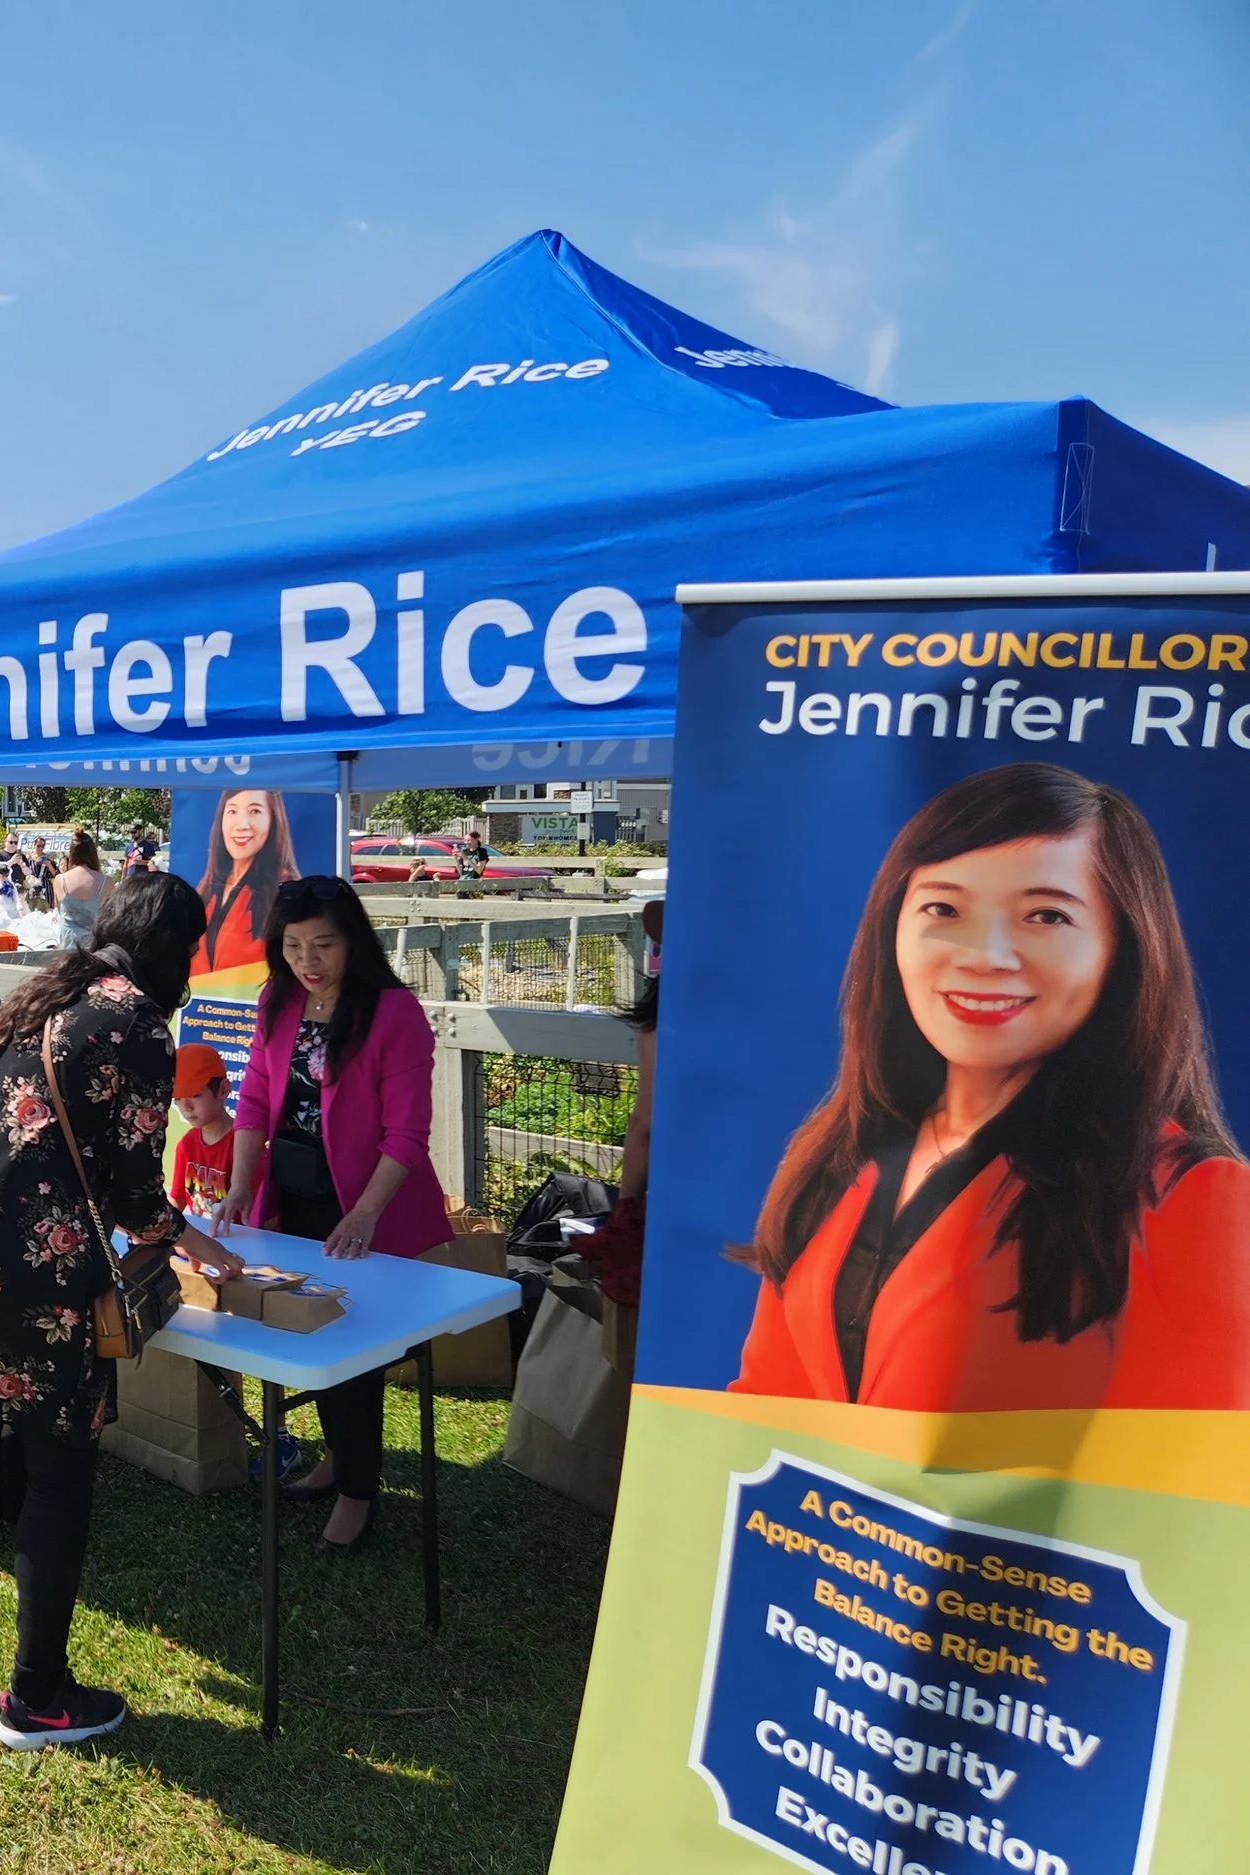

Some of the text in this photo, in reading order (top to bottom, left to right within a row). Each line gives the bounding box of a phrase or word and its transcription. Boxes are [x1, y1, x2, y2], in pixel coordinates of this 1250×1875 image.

[207, 359, 610, 461] Jennifer Rice
[290, 410, 426, 457] YEG
[280, 570, 649, 723] Rice
[765, 632, 1249, 671] CITY COUNCILLOR
[758, 677, 1104, 743] Jennifer
[531, 817, 578, 829] VISTA
[197, 1004, 258, 1019] A Common-Se
[224, 1021, 234, 1030] to
[235, 1021, 256, 1033] Gett
[745, 1510, 1154, 1672] Approach to Getting the
[799, 1489, 1093, 1605] A Common-Sense
[814, 1578, 1048, 1685] Balance Right.
[765, 1603, 1102, 1768] Responsibility
[812, 1685, 1017, 1801] Integrity
[755, 1718, 1069, 1875] Collaboration
[775, 1785, 948, 1875] Excell
